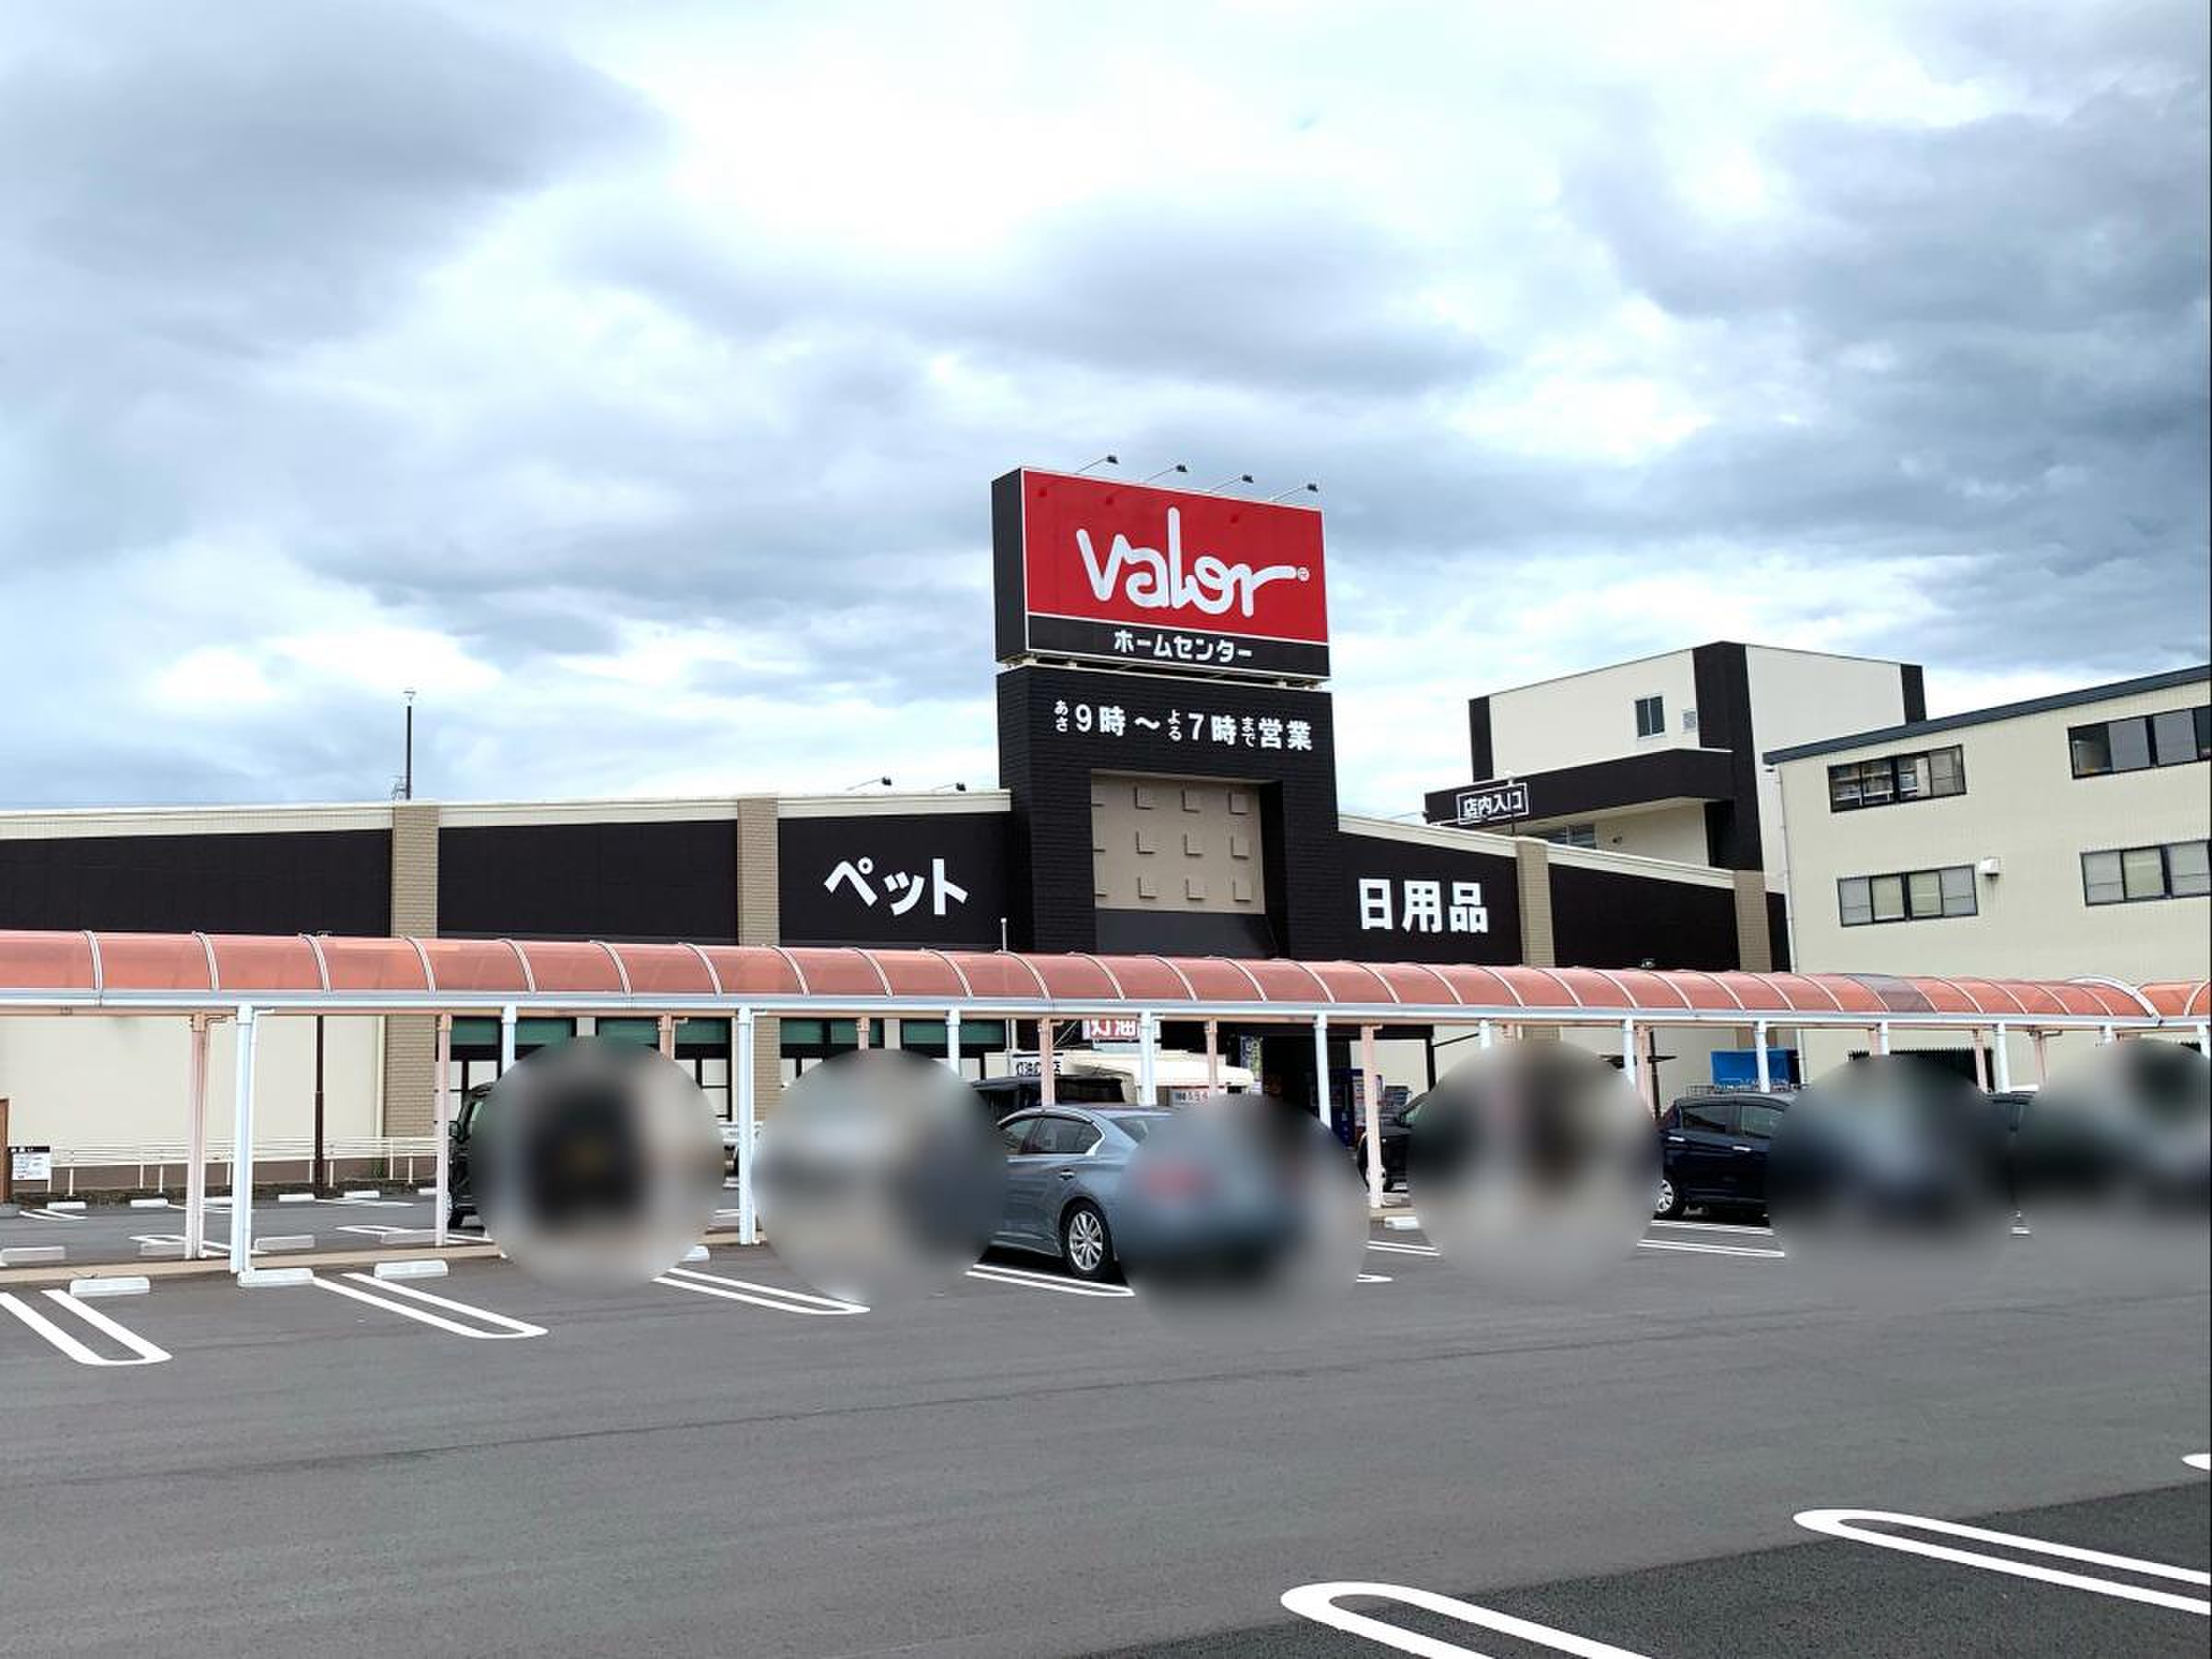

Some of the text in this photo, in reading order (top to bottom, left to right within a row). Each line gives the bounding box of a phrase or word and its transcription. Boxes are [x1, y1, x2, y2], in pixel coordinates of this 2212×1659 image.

[1113, 629, 1253, 664] ホームセンター
[1463, 791, 1523, 818] 店内入口
[823, 856, 969, 916] ペット
[1359, 877, 1488, 934] 日用品
